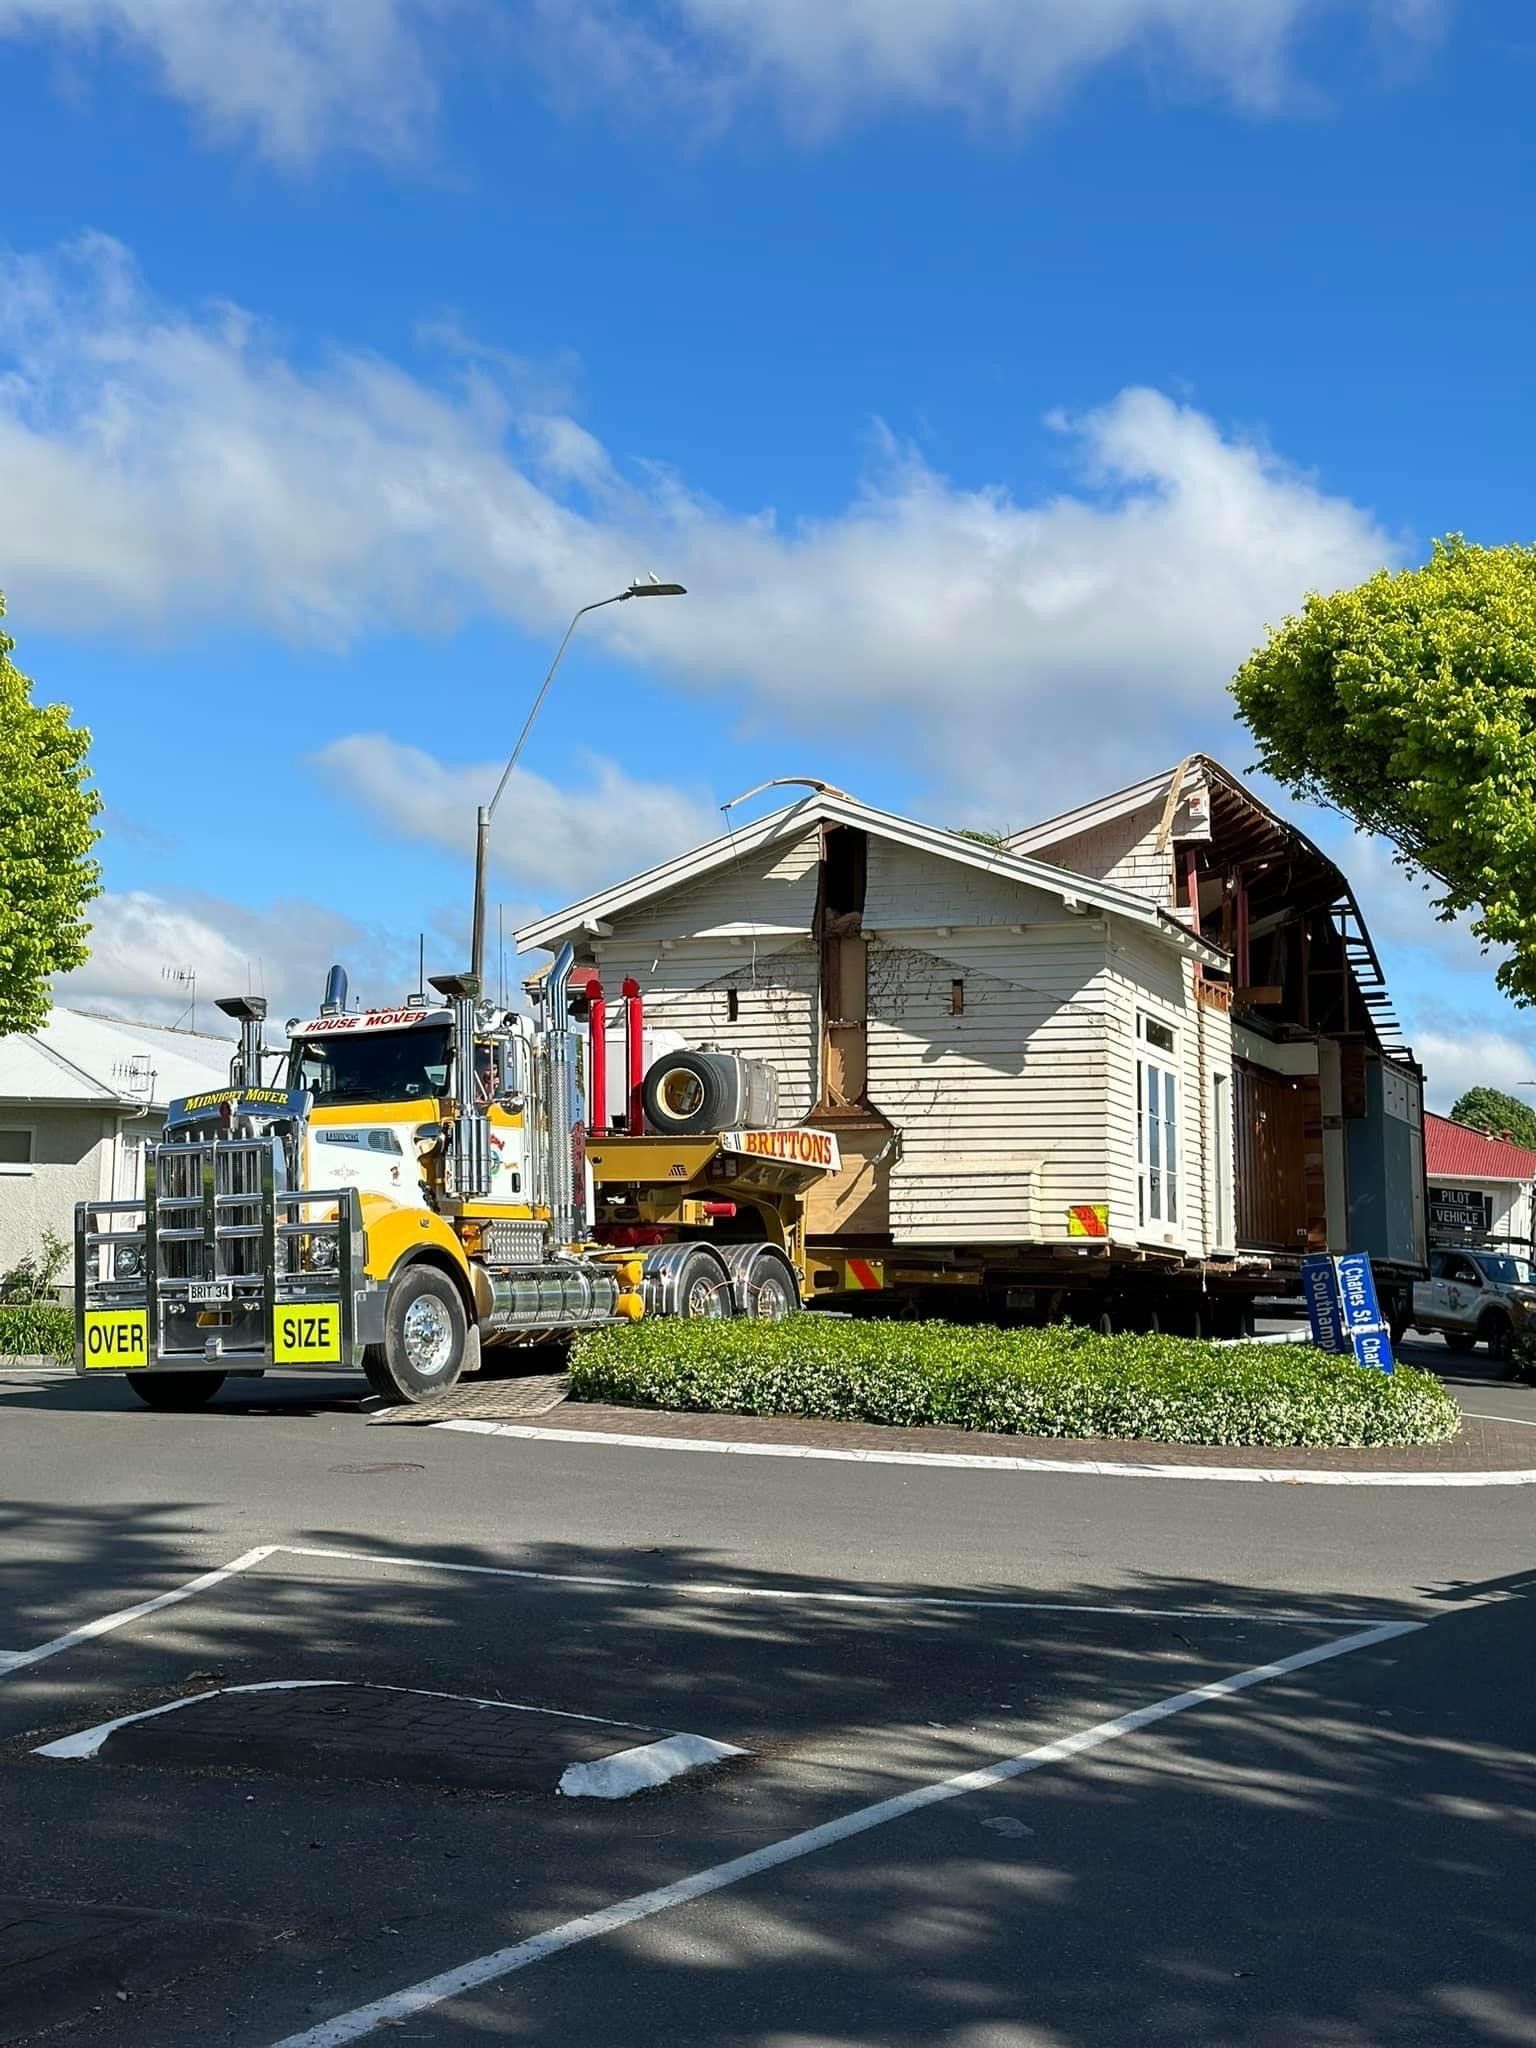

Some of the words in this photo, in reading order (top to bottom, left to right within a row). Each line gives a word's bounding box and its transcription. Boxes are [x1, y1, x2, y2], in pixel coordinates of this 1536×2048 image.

[304, 1016, 361, 1032] HOUSE
[366, 1011, 429, 1027] MOVER
[184, 1089, 245, 1112] MIDNIGHT
[245, 1087, 289, 1106] MOVER
[745, 1130, 832, 1165] BRITTONS
[1441, 1190, 1471, 1204] PILOT
[1436, 1209, 1479, 1225] VEHICLE
[191, 1285, 212, 1299] BRIT
[215, 1286, 228, 1298] 34
[1343, 1267, 1367, 1306] Charles
[1352, 1309, 1372, 1323] St
[88, 1324, 144, 1354] OVER
[283, 1318, 330, 1349] SIZE
